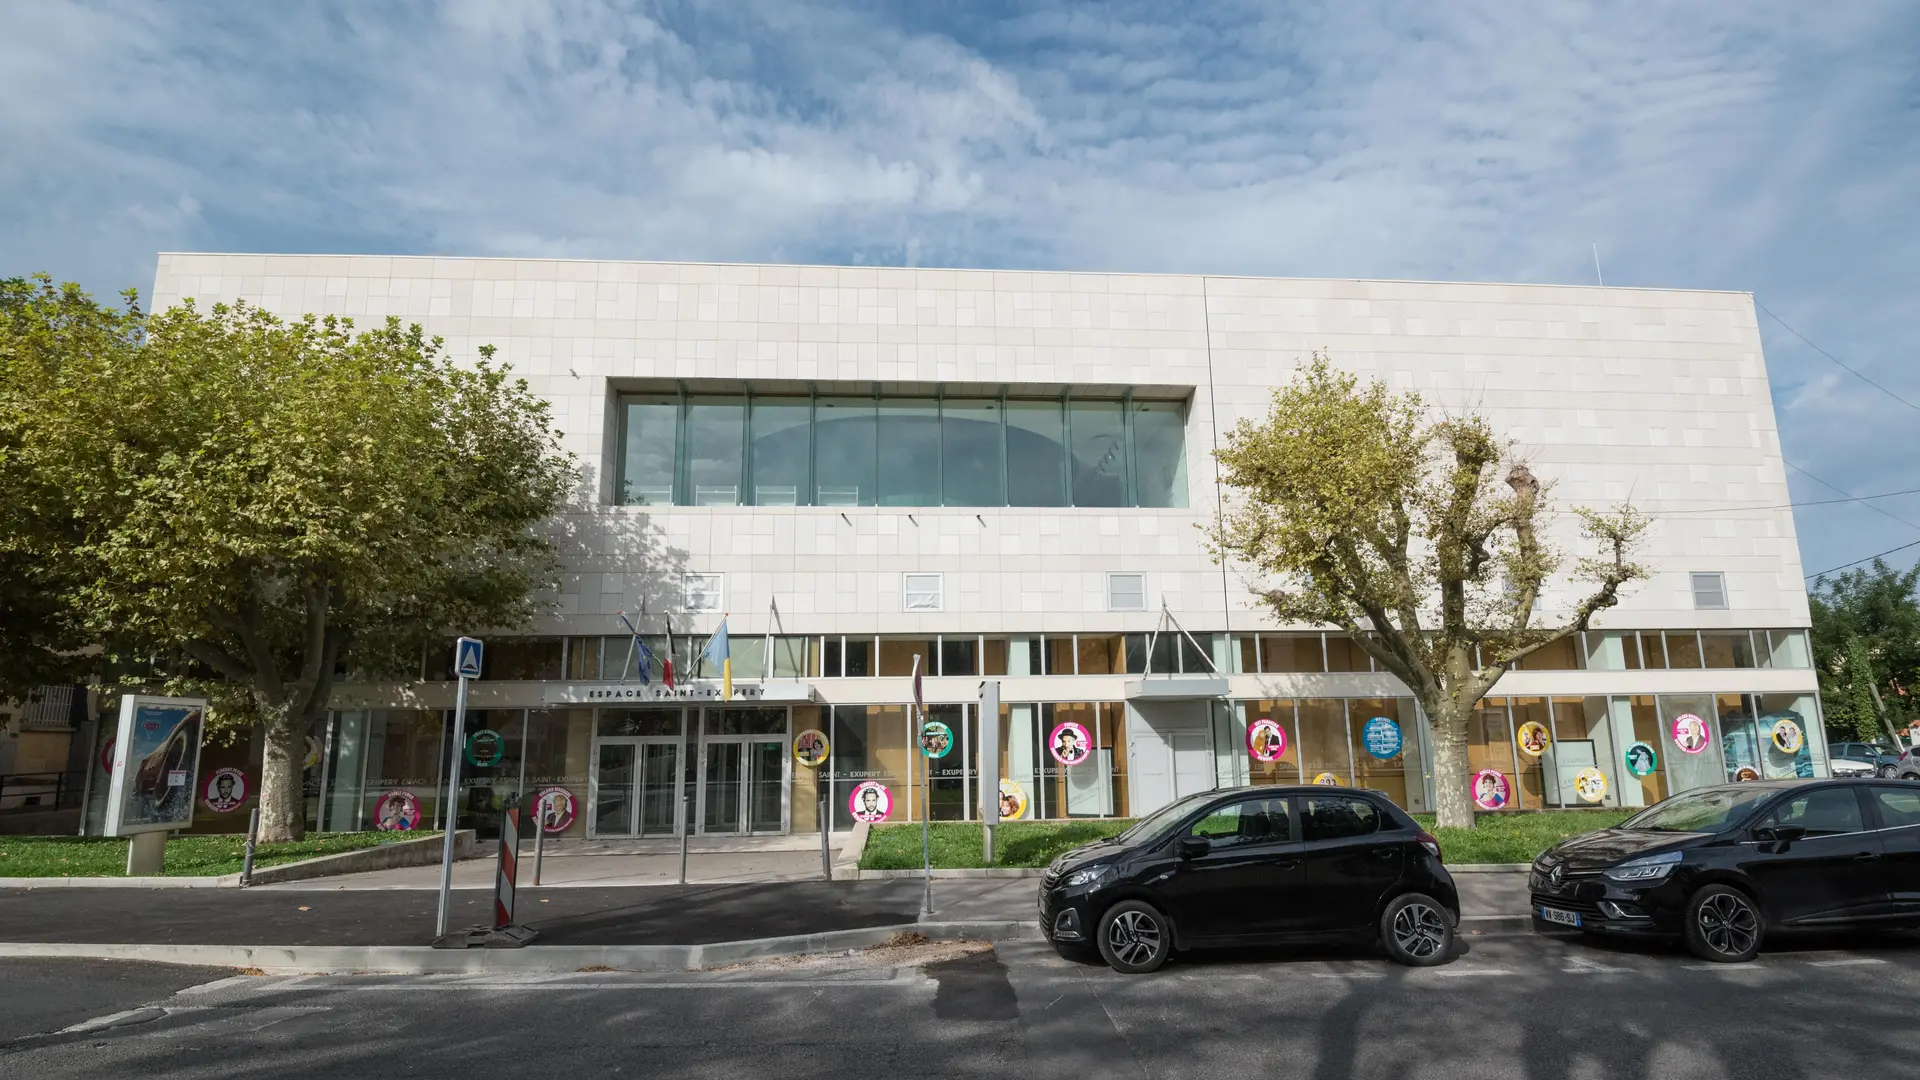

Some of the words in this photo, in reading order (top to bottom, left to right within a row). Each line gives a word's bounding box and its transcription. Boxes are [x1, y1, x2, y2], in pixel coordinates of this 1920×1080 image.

[589, 690, 641, 699] ESPACE
[655, 688, 764, 698] SAINT-EXPERY
[849, 768, 880, 777] EXUPERY
